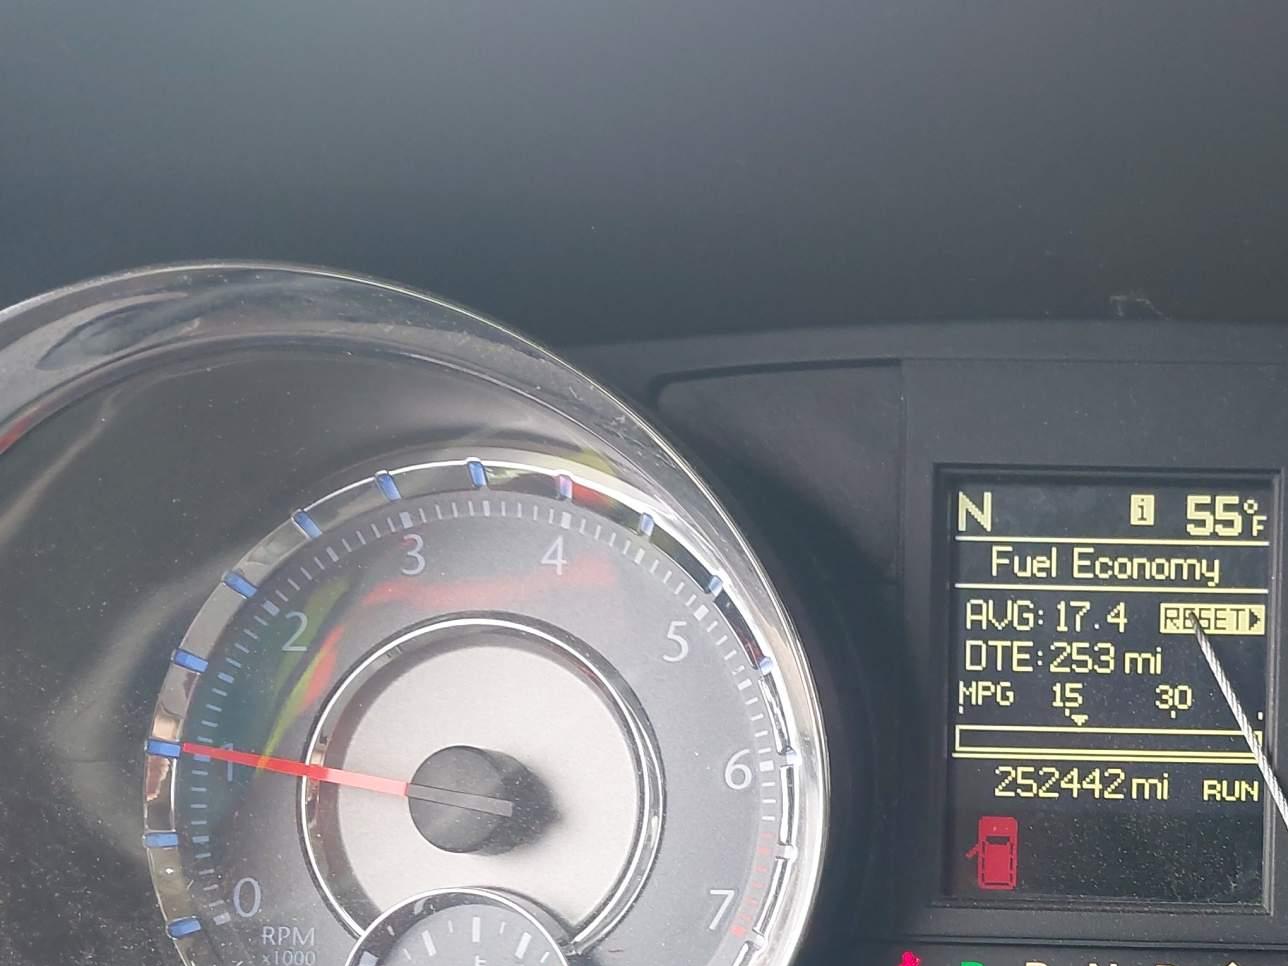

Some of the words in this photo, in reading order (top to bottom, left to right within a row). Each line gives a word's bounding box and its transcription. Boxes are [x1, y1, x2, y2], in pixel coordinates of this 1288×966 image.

[957, 491, 992, 532] N
[400, 533, 426, 576] 3
[540, 536, 567, 576] 4
[991, 546, 1057, 578] Fuel
[1072, 547, 1221, 588] Economy
[281, 612, 309, 652] 2
[1056, 601, 1128, 633] 17.4
[661, 621, 690, 663] 5
[1124, 647, 1162, 675] mi
[958, 681, 1014, 706] MPG
[1052, 683, 1083, 708] 15
[1155, 685, 1193, 710] 30
[222, 743, 235, 782] 1
[724, 748, 753, 791] 6
[994, 766, 1125, 799] 252442
[1131, 773, 1169, 800] mi
[1203, 780, 1259, 802] RUN
[233, 877, 261, 917] 0
[707, 889, 736, 932] 7
[262, 926, 315, 946] RPM
